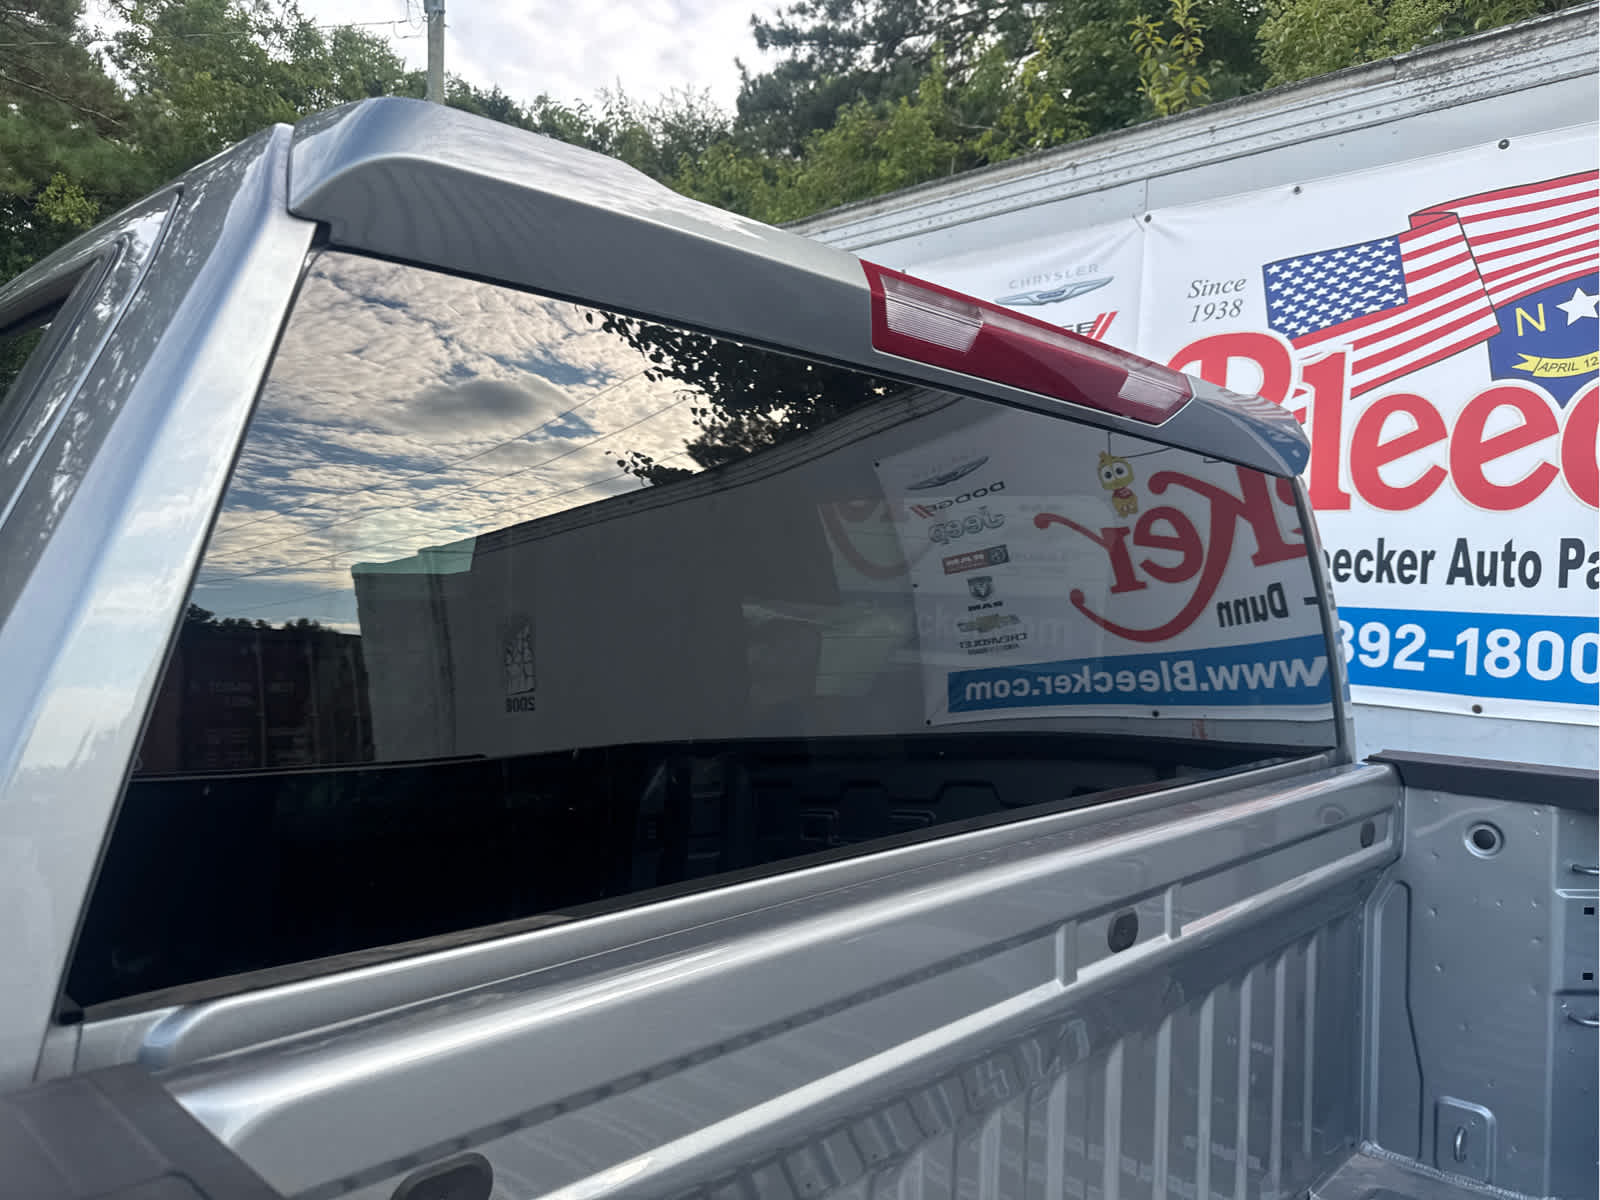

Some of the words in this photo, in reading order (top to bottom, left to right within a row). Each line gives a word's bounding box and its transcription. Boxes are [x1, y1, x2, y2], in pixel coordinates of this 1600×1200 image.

[1008, 263, 1099, 290] CHRYSLER
[1187, 278, 1247, 299] Since
[1189, 299, 1244, 324] 1938
[1516, 303, 1546, 336] N
[1537, 362, 1580, 373] APRIL
[1446, 537, 1542, 588] Auto
